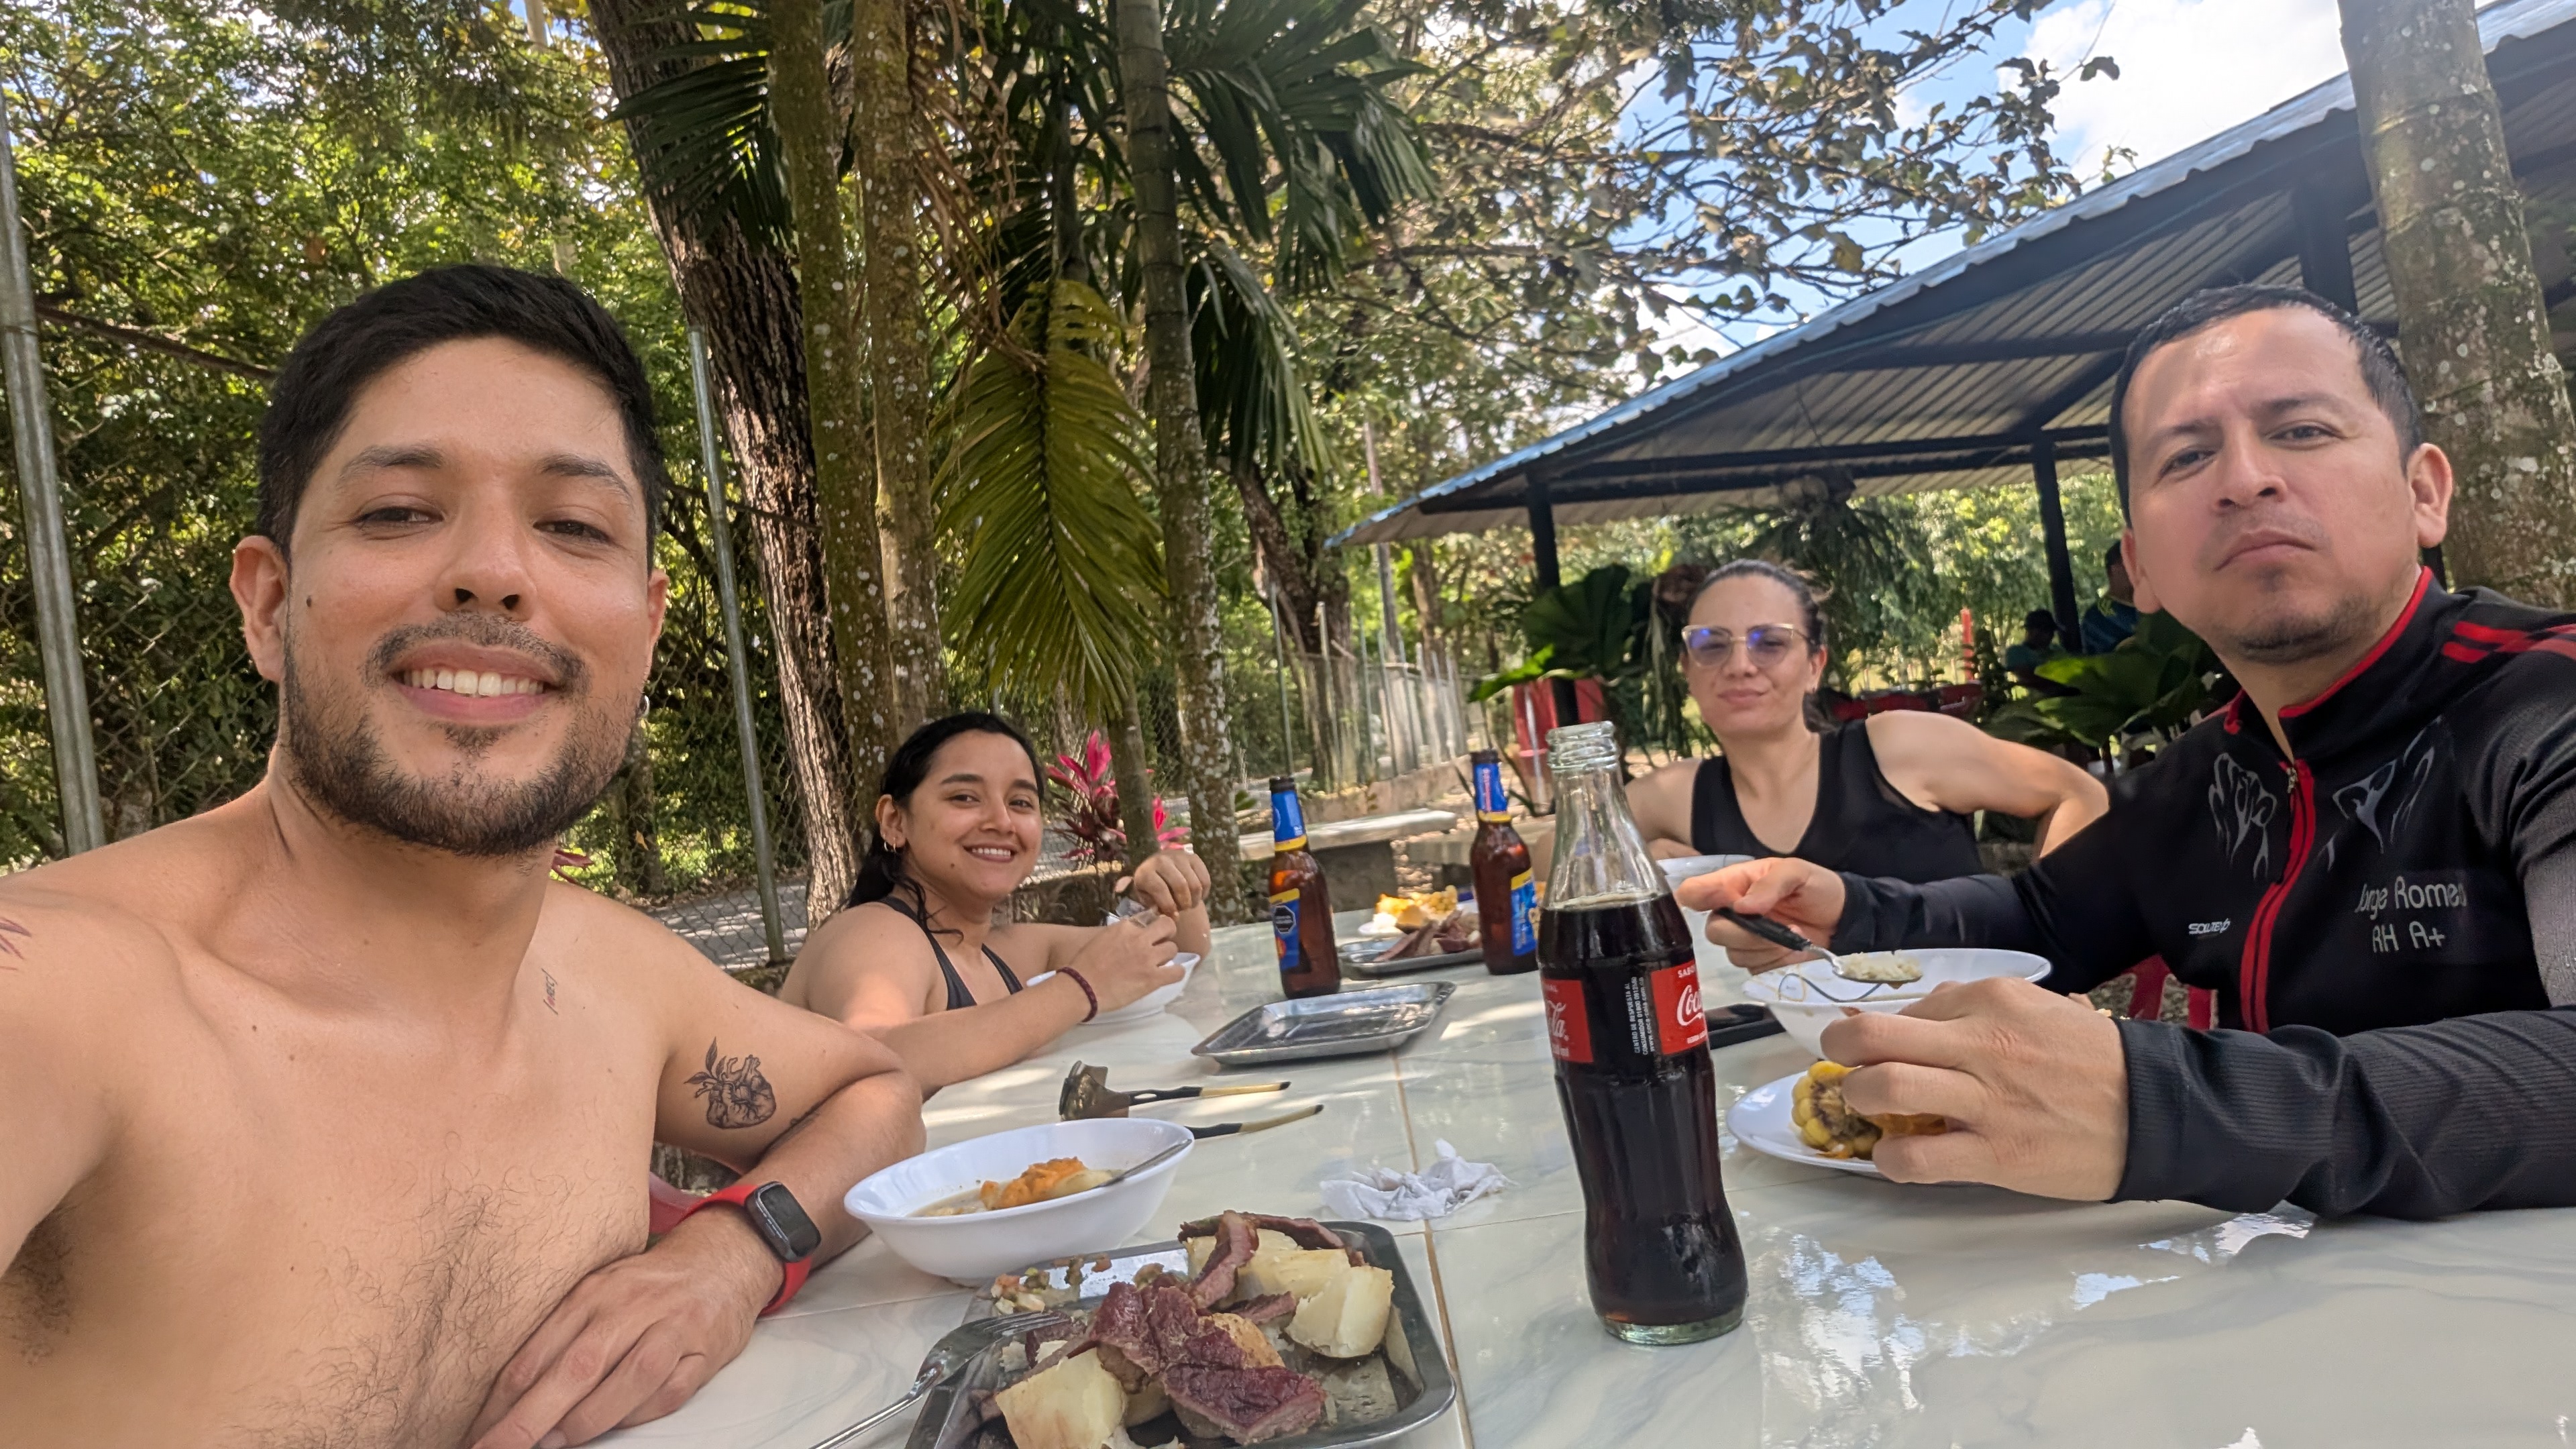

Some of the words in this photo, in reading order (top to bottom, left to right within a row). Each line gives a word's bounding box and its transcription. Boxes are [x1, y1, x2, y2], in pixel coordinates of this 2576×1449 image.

[2372, 923, 2400, 953] RH
[2408, 920, 2446, 950] A+
[1625, 990, 1637, 1022] RESPUESTA
[1630, 1023, 1638, 1031] DE
[1631, 1031, 1641, 1053] CENTRO
[1637, 1018, 1649, 1055] CONSUMIDOR
